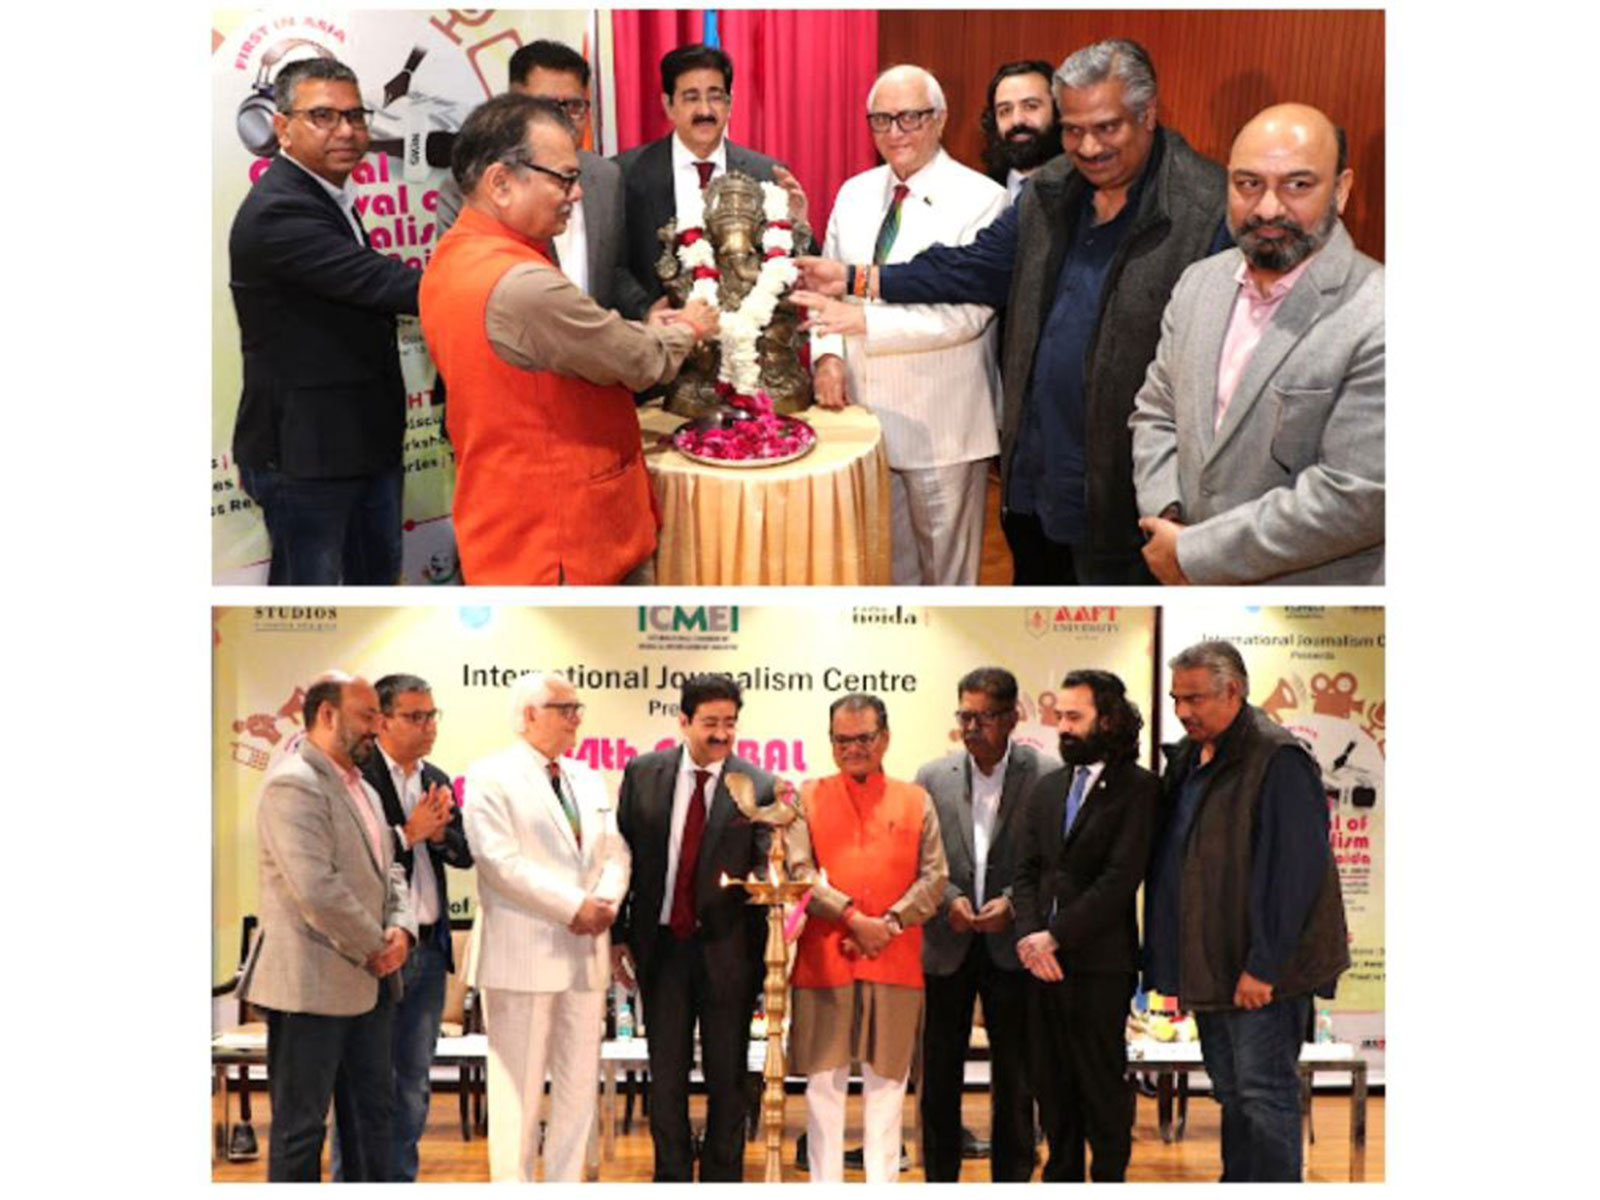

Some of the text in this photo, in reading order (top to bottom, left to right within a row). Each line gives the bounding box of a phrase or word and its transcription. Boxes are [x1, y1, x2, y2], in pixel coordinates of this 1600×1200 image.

[235, 16, 346, 70] FIRST IN ASIA
[254, 606, 338, 620] STUDIOS
[638, 605, 740, 632] ICMEI
[823, 666, 917, 692] Centre
[1347, 814, 1368, 832] of
